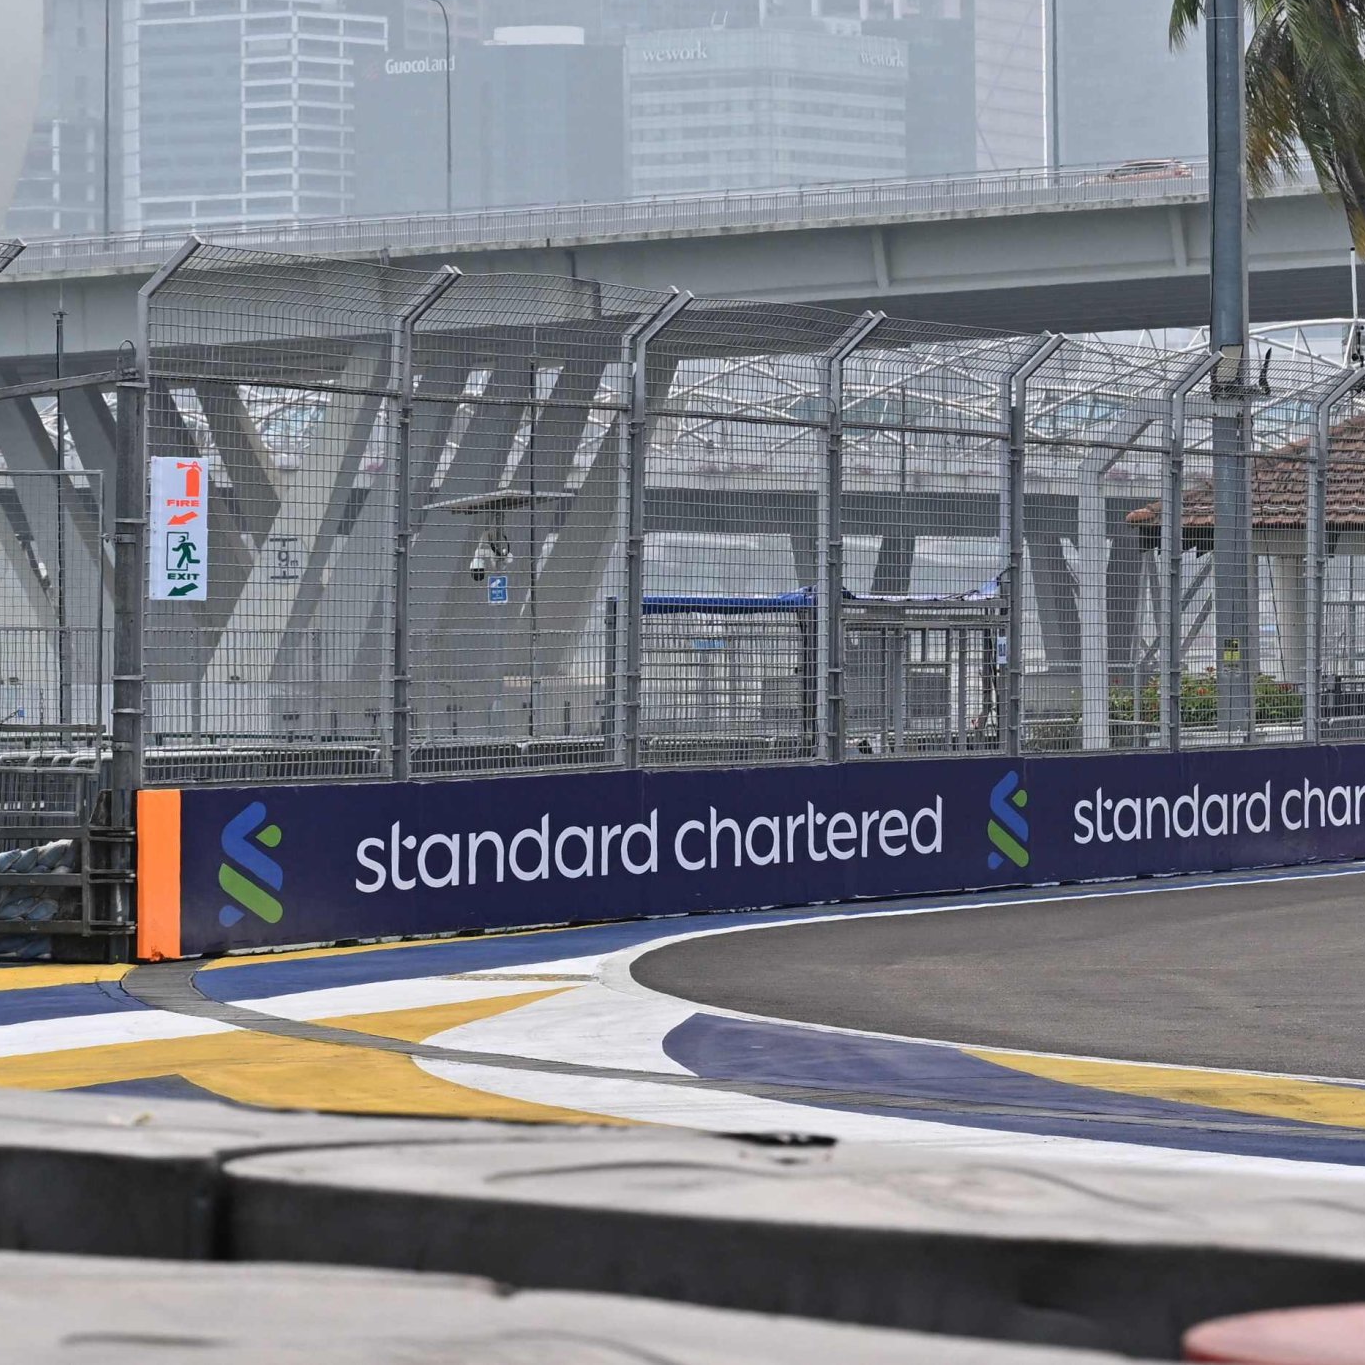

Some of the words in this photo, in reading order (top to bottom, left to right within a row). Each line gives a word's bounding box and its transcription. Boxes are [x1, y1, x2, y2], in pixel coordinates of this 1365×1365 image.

[642, 41, 707, 62] wework
[385, 56, 455, 74] GuocoLand
[166, 499, 200, 507] FIRE
[1074, 780, 1271, 845] standard
[355, 807, 658, 893] standard
[674, 793, 943, 871] chartered
